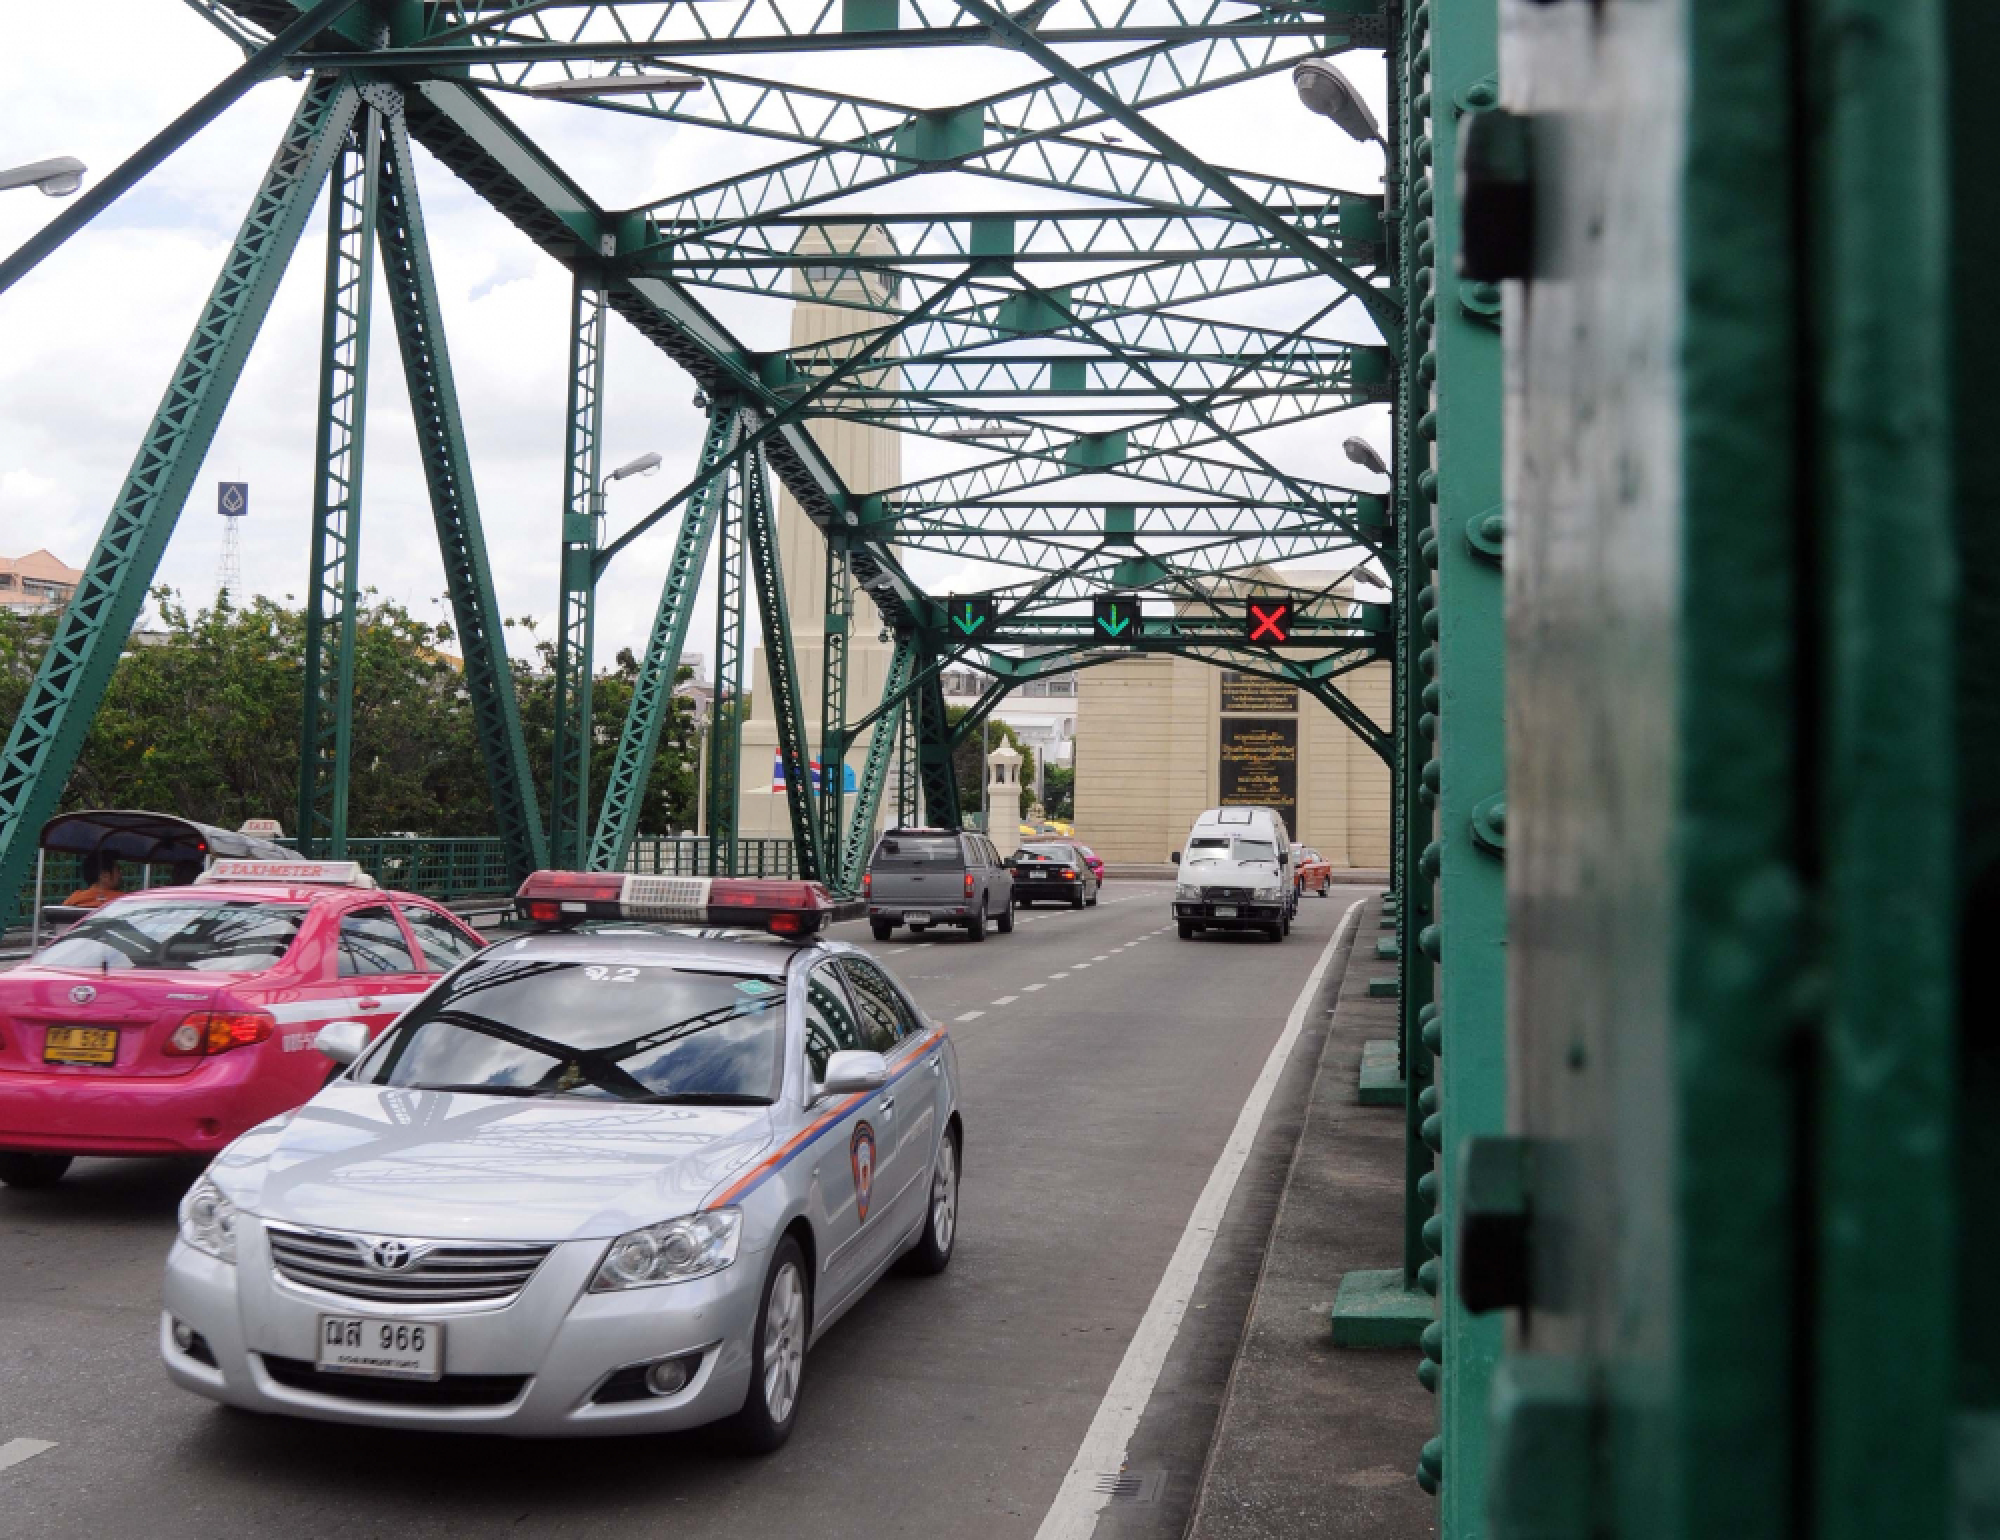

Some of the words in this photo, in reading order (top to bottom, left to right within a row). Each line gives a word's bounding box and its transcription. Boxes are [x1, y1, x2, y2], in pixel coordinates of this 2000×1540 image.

[247, 821, 275, 831] TAXI
[231, 863, 324, 877] TAXI-METER
[379, 1323, 426, 1352] 966
